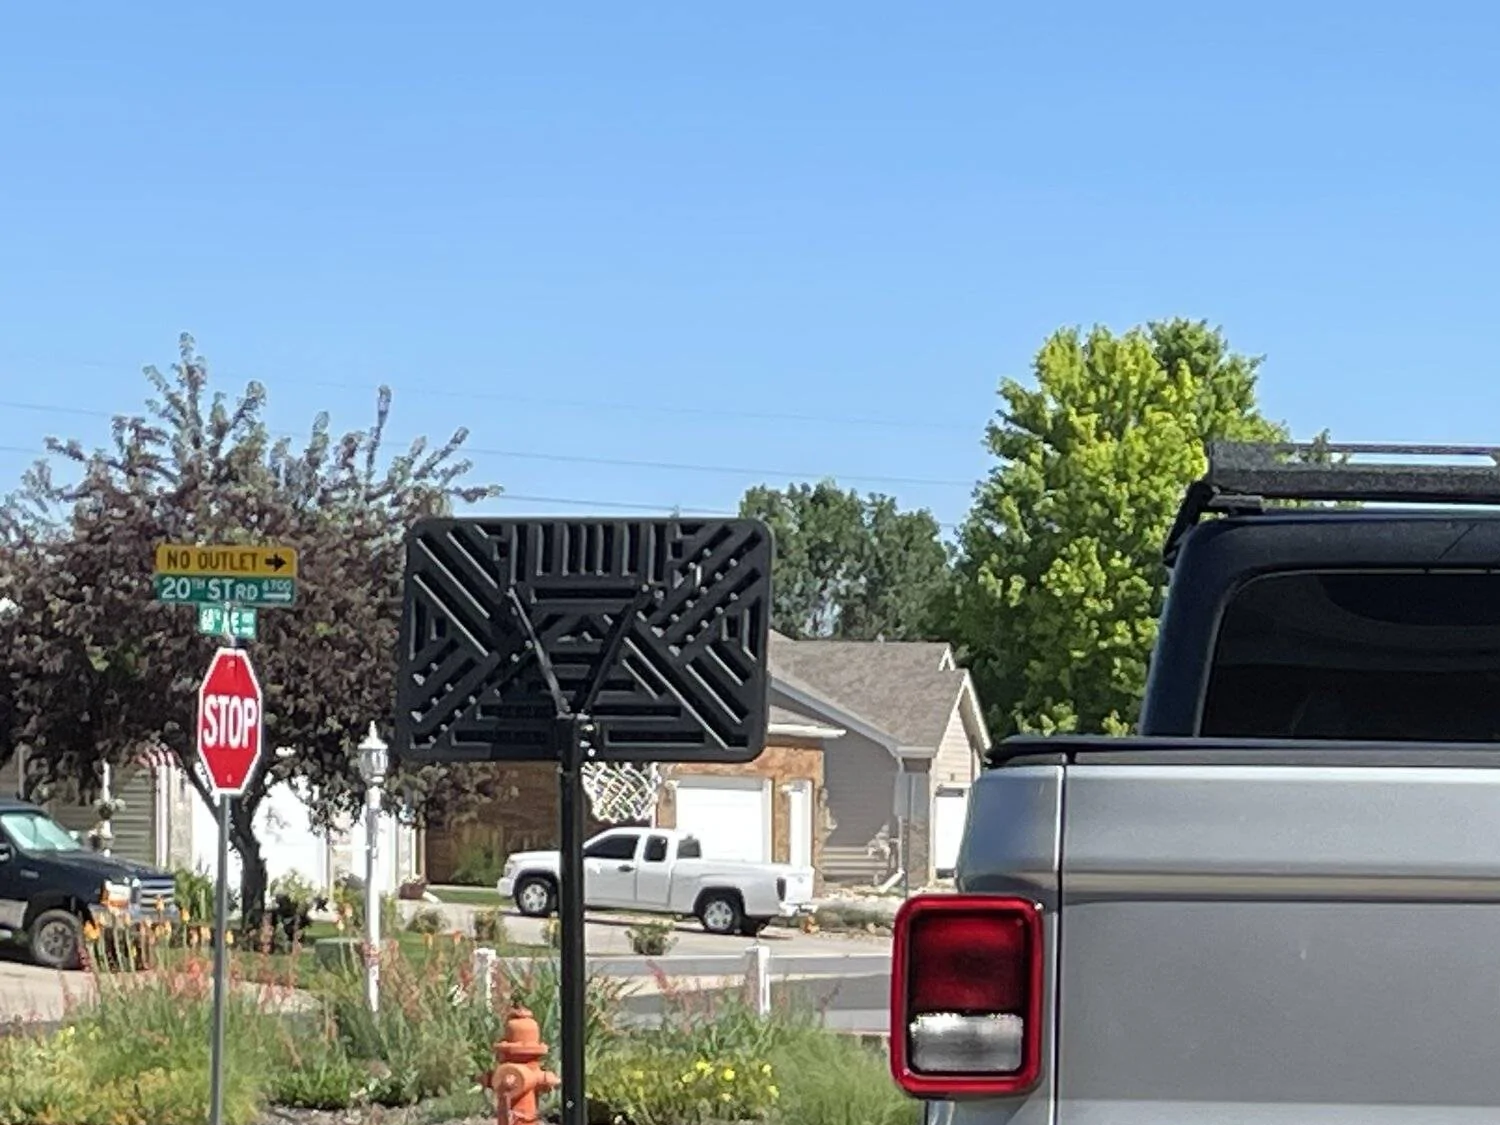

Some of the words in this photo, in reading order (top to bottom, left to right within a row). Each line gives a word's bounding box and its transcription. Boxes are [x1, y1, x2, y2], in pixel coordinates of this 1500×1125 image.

[166, 551, 191, 570] NO
[198, 551, 258, 571] OUTLET
[203, 695, 257, 748] STOP
